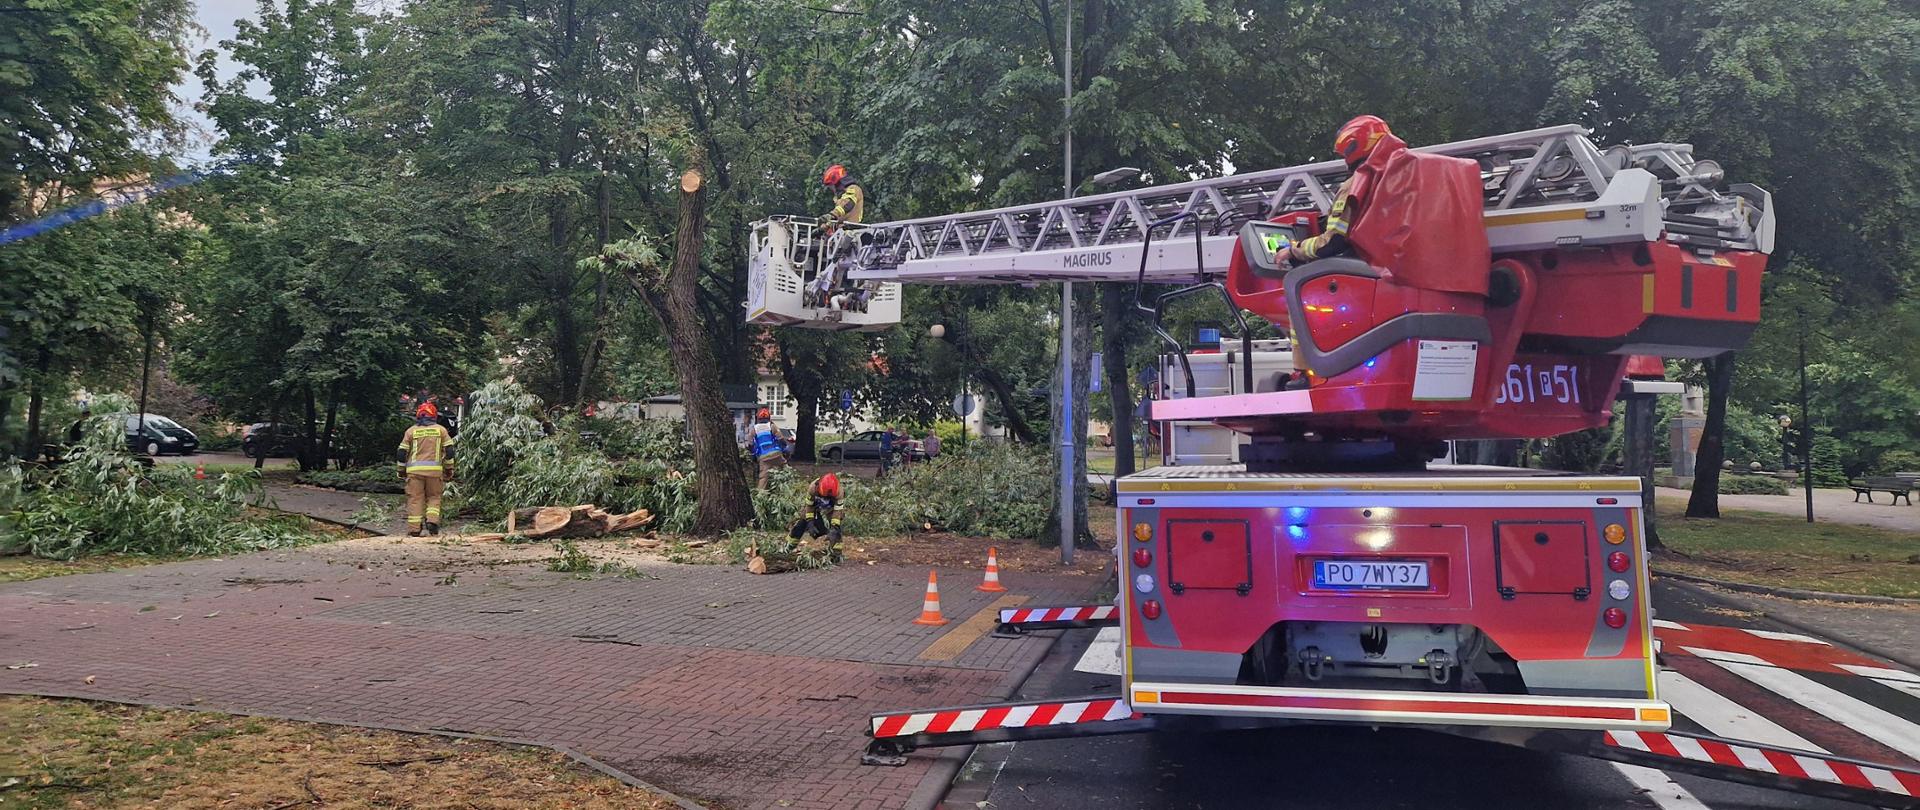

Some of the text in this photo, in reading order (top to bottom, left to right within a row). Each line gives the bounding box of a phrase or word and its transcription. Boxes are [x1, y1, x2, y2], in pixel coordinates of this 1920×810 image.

[1619, 204, 1637, 212] 32m
[1063, 251, 1112, 268] MAGIRUS
[1328, 564, 1421, 584] PO 7WY37
